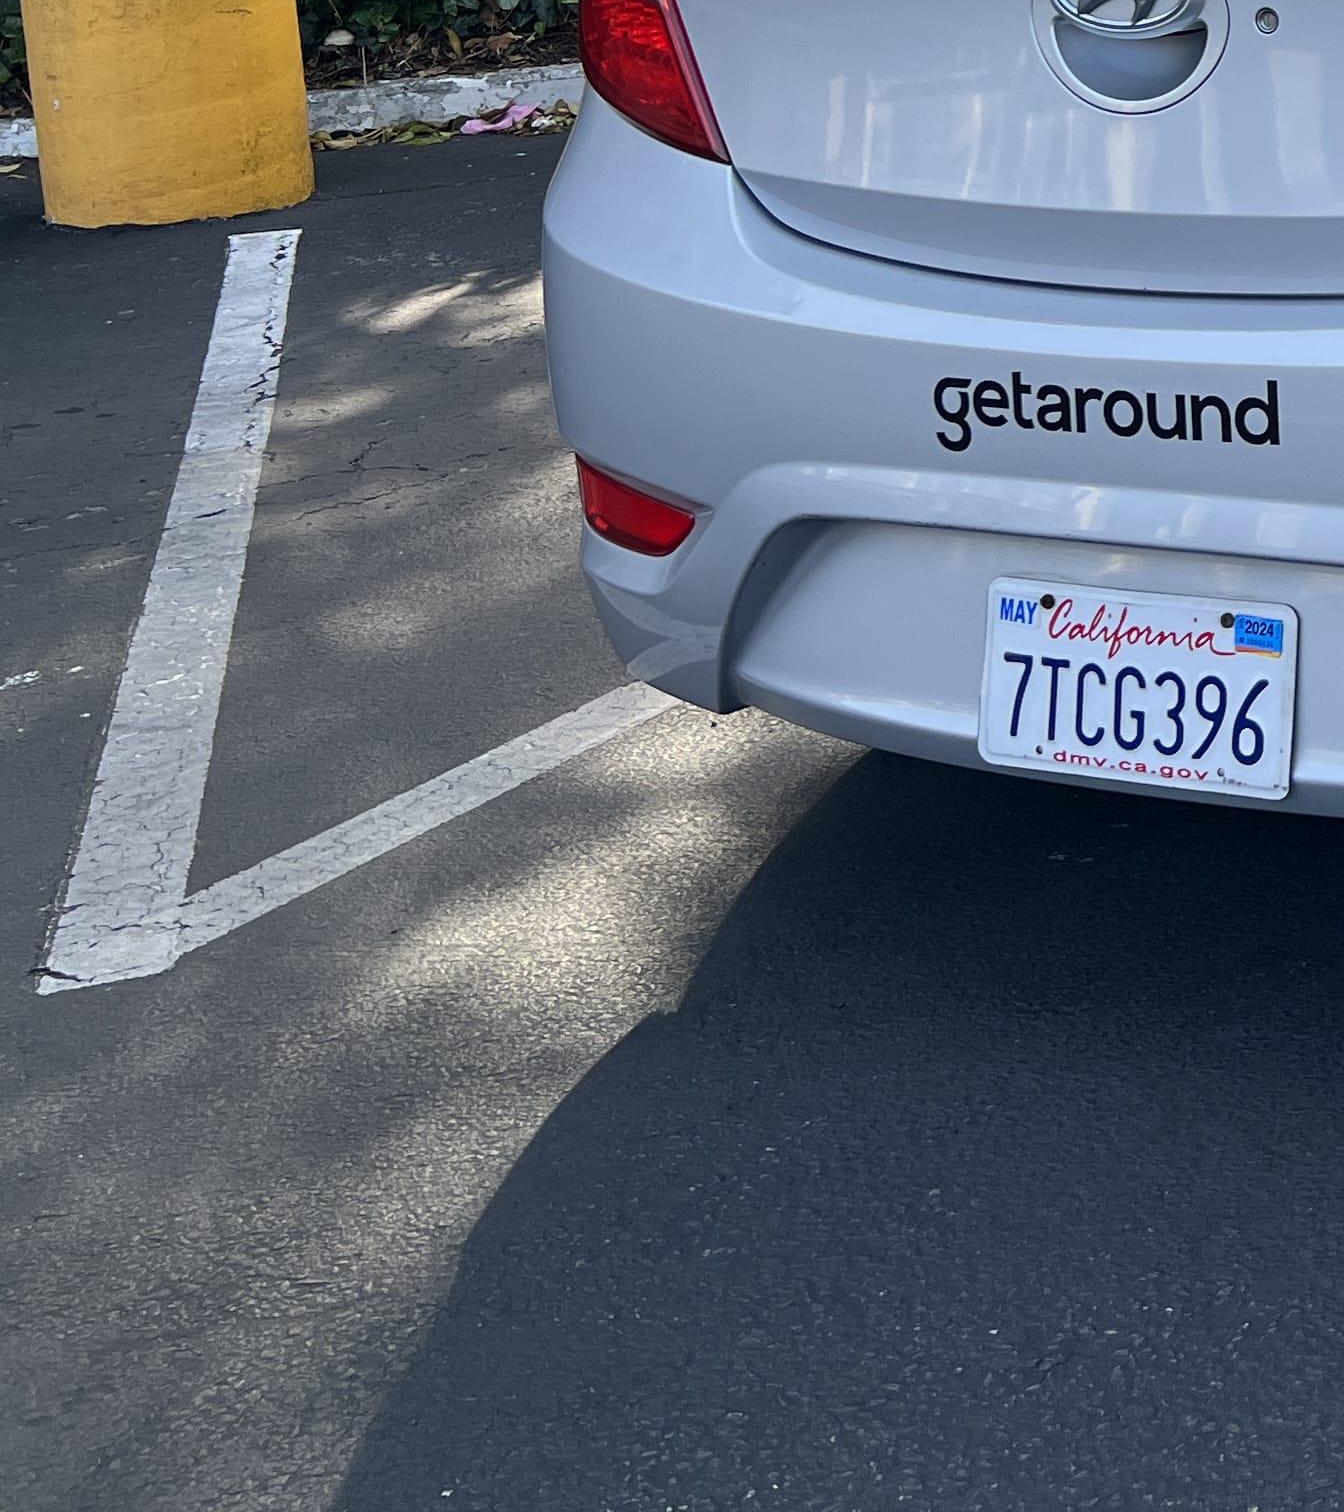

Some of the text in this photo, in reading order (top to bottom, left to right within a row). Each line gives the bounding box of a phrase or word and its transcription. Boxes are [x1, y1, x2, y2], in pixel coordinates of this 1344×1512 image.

[934, 370, 1281, 453] getaround
[999, 597, 1038, 626] MAY
[1048, 598, 1236, 659] California
[1245, 619, 1274, 637] 2024
[1003, 651, 1269, 767] 7TCG396
[1053, 750, 1209, 781] dmv.ca.gov
